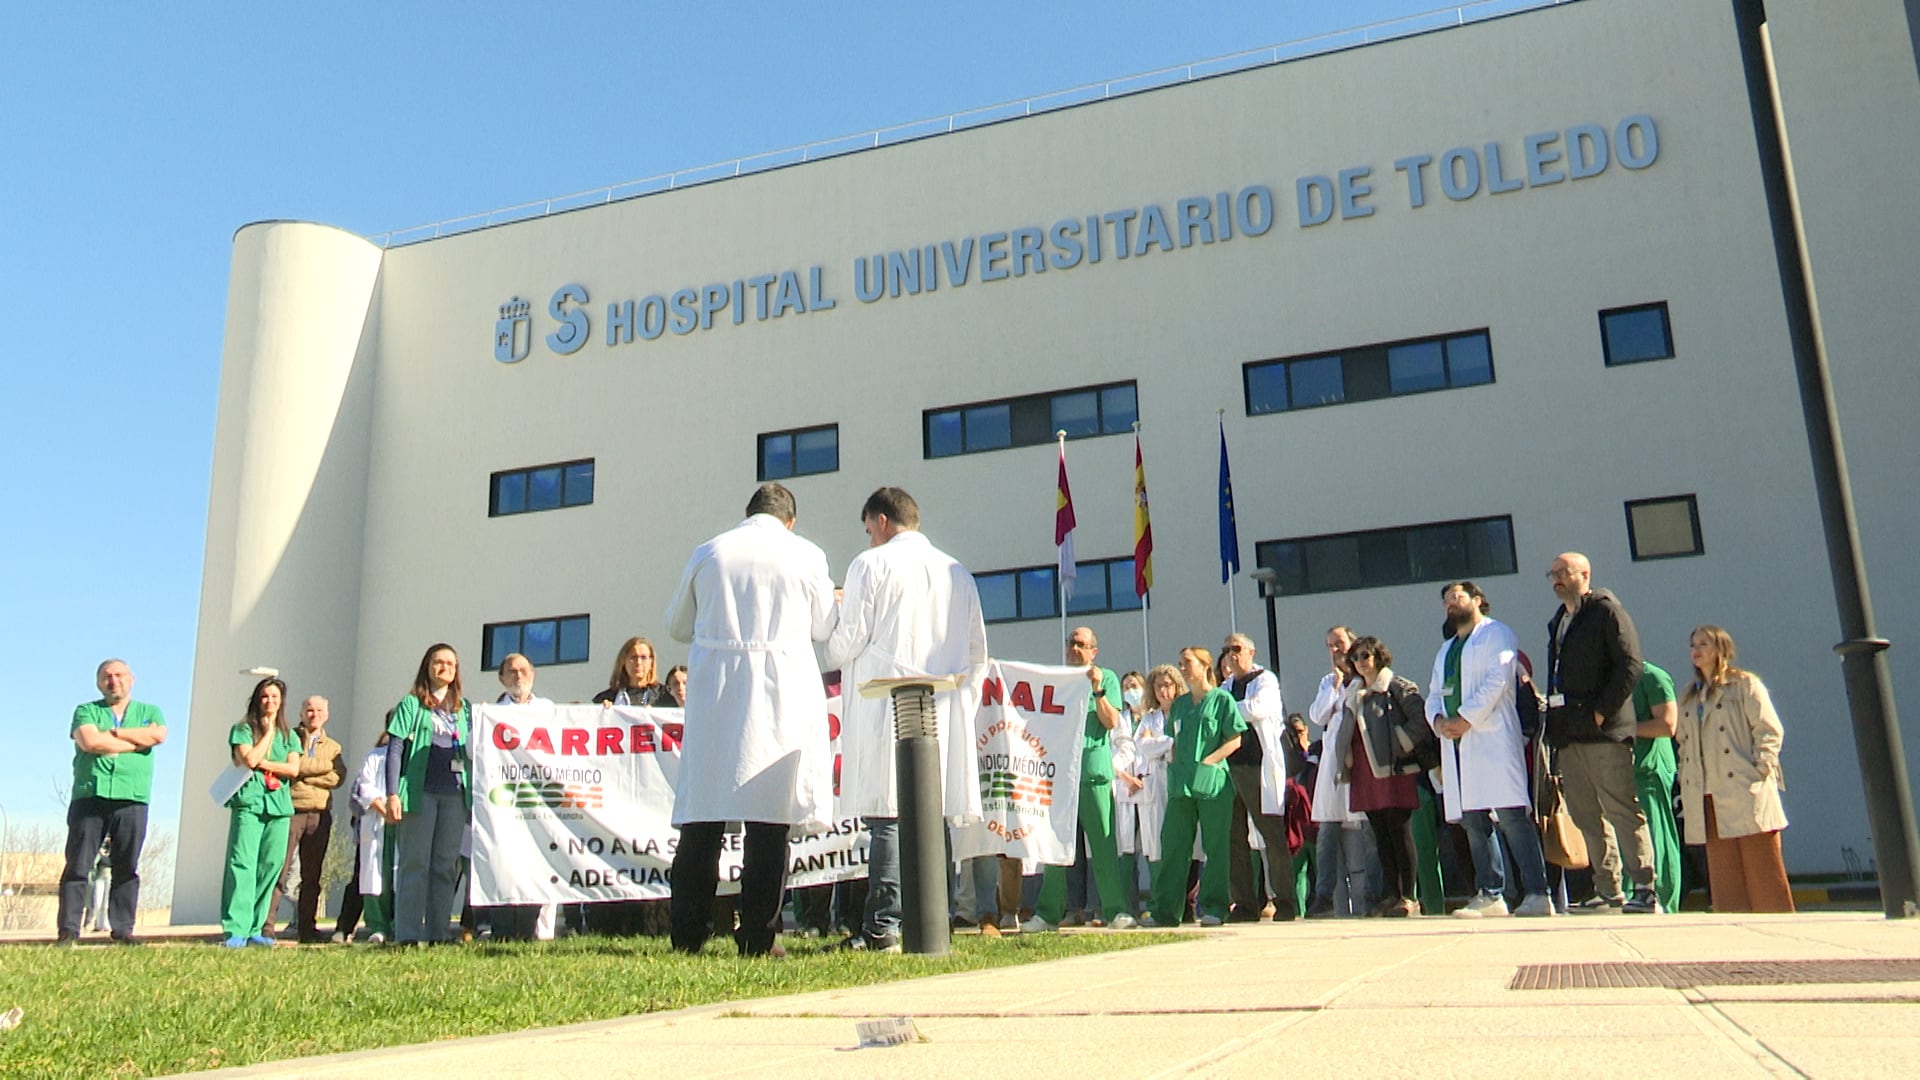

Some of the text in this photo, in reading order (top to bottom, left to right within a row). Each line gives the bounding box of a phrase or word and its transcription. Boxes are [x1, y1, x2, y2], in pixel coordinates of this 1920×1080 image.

[605, 114, 1660, 346] HOSPITAL UNIVERSITARIO DE TOLEDO
[982, 677, 1065, 715] NAL
[555, 765, 603, 784] MÉDICO
[1012, 754, 1057, 778] MÉDICO
[568, 837, 605, 855] NO
[610, 838, 628, 855] A
[632, 837, 660, 855] LA
